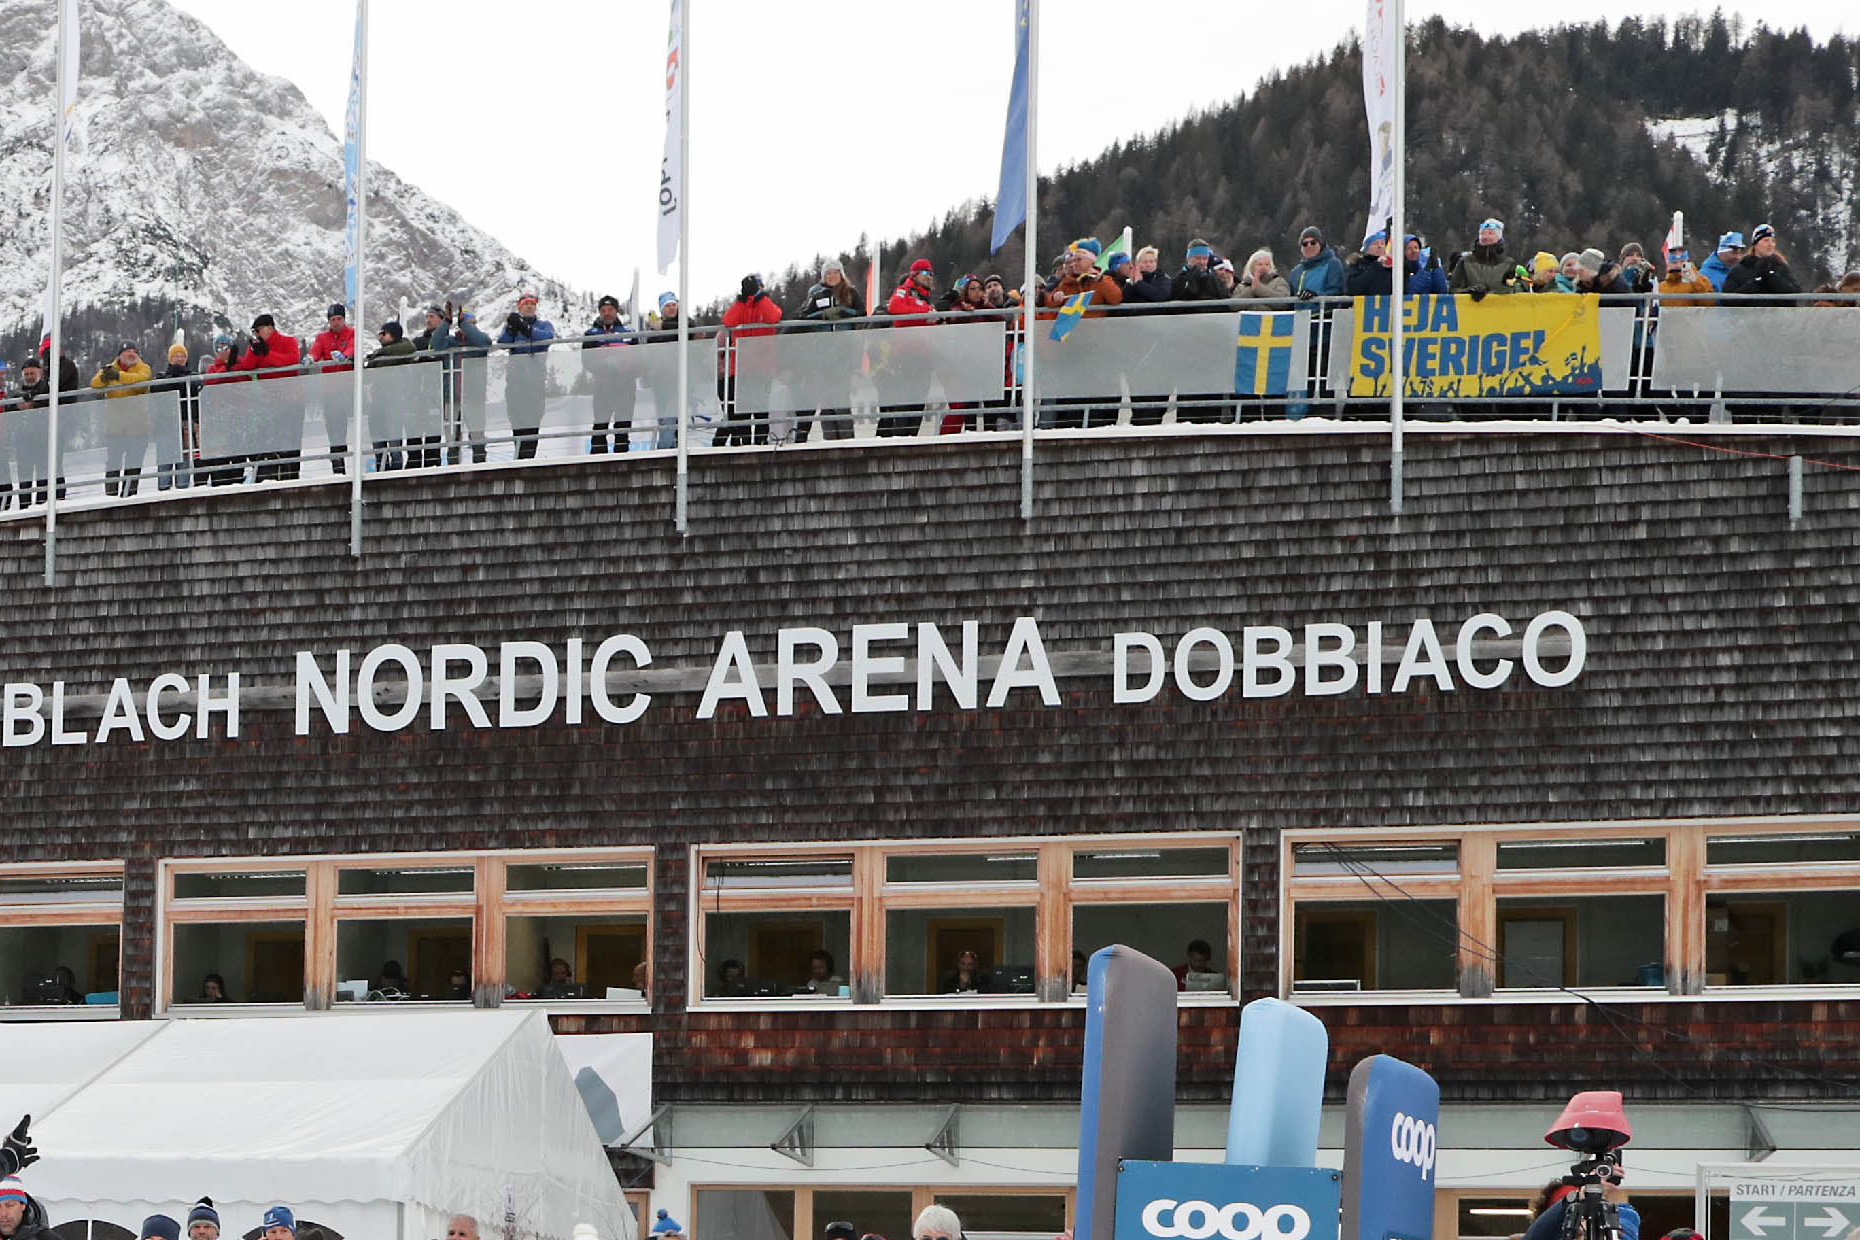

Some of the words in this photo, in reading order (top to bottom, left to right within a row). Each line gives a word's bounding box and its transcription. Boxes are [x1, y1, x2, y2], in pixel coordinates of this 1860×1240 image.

[1362, 295, 1459, 333] HEJA
[295, 634, 652, 735] NORDIC
[695, 616, 1062, 719] ARENA
[1113, 610, 1587, 704] DOBBIACO
[1391, 1111, 1436, 1181] coop
[1736, 1184, 1777, 1197] START
[1788, 1184, 1857, 1198] PARTENZA
